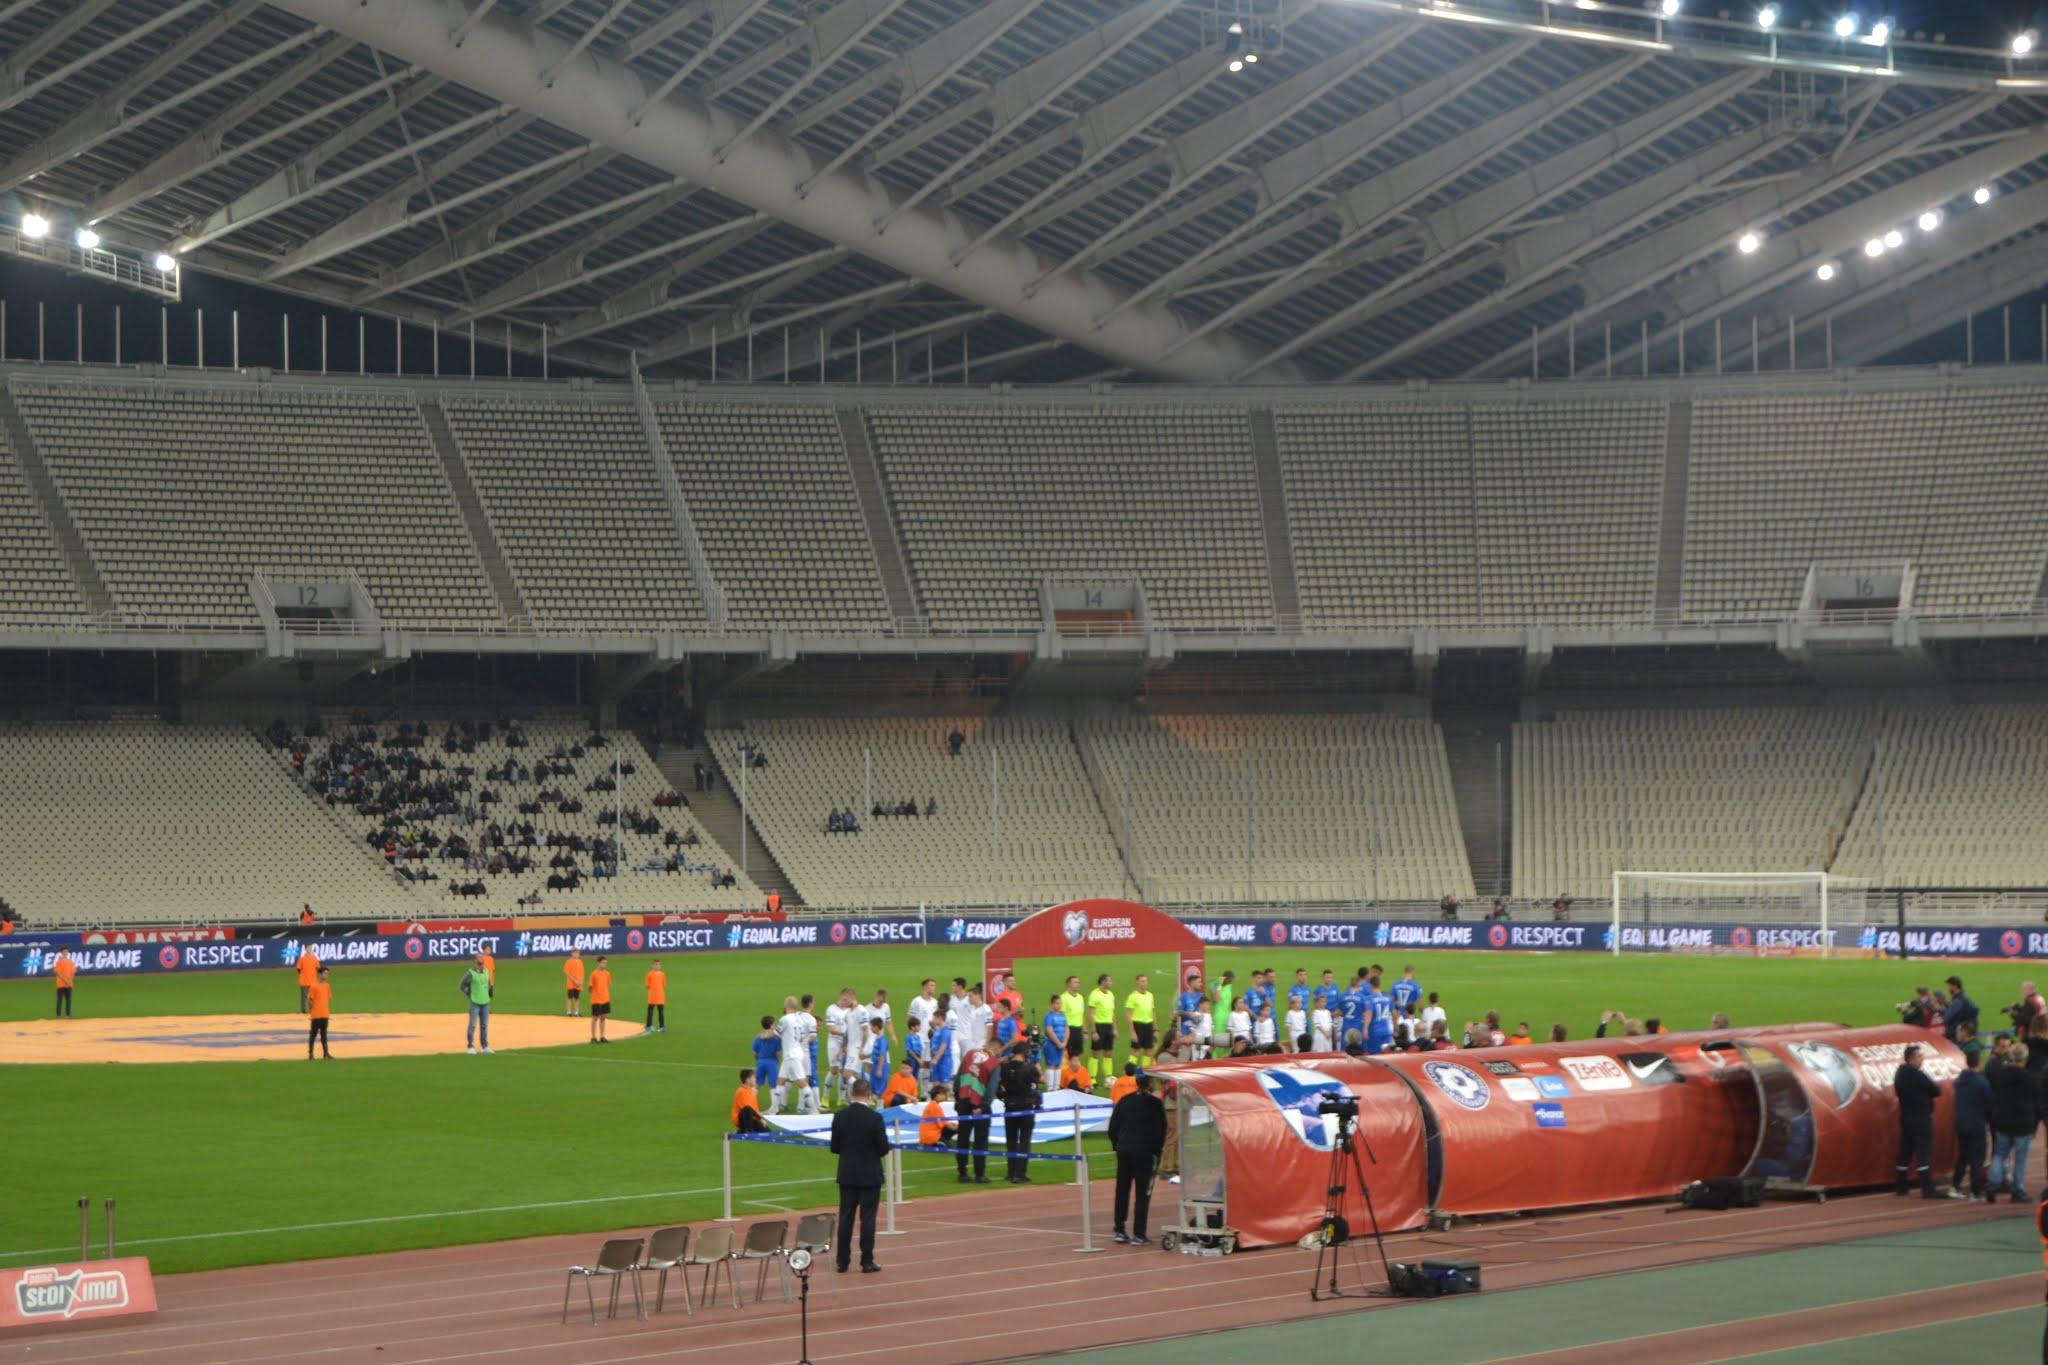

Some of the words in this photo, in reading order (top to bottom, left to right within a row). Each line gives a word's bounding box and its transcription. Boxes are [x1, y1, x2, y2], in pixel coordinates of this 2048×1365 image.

[298, 586, 319, 606] 12
[1856, 578, 1874, 597] 16
[1085, 589, 1102, 608] 14
[850, 922, 924, 940] RESPECT
[1093, 918, 1131, 928] EUROPEAN
[649, 929, 714, 949] RESPECT
[1088, 928, 1136, 940] QUALIFIERS
[1291, 924, 1358, 943] RESPECT
[1511, 927, 1585, 946] RESPECT
[1756, 929, 1838, 949] RESPECT
[186, 944, 264, 965] RESPECT
[428, 936, 500, 956] RESPECT
[1344, 1001, 1356, 1020] 2
[1375, 1002, 1390, 1021] 14
